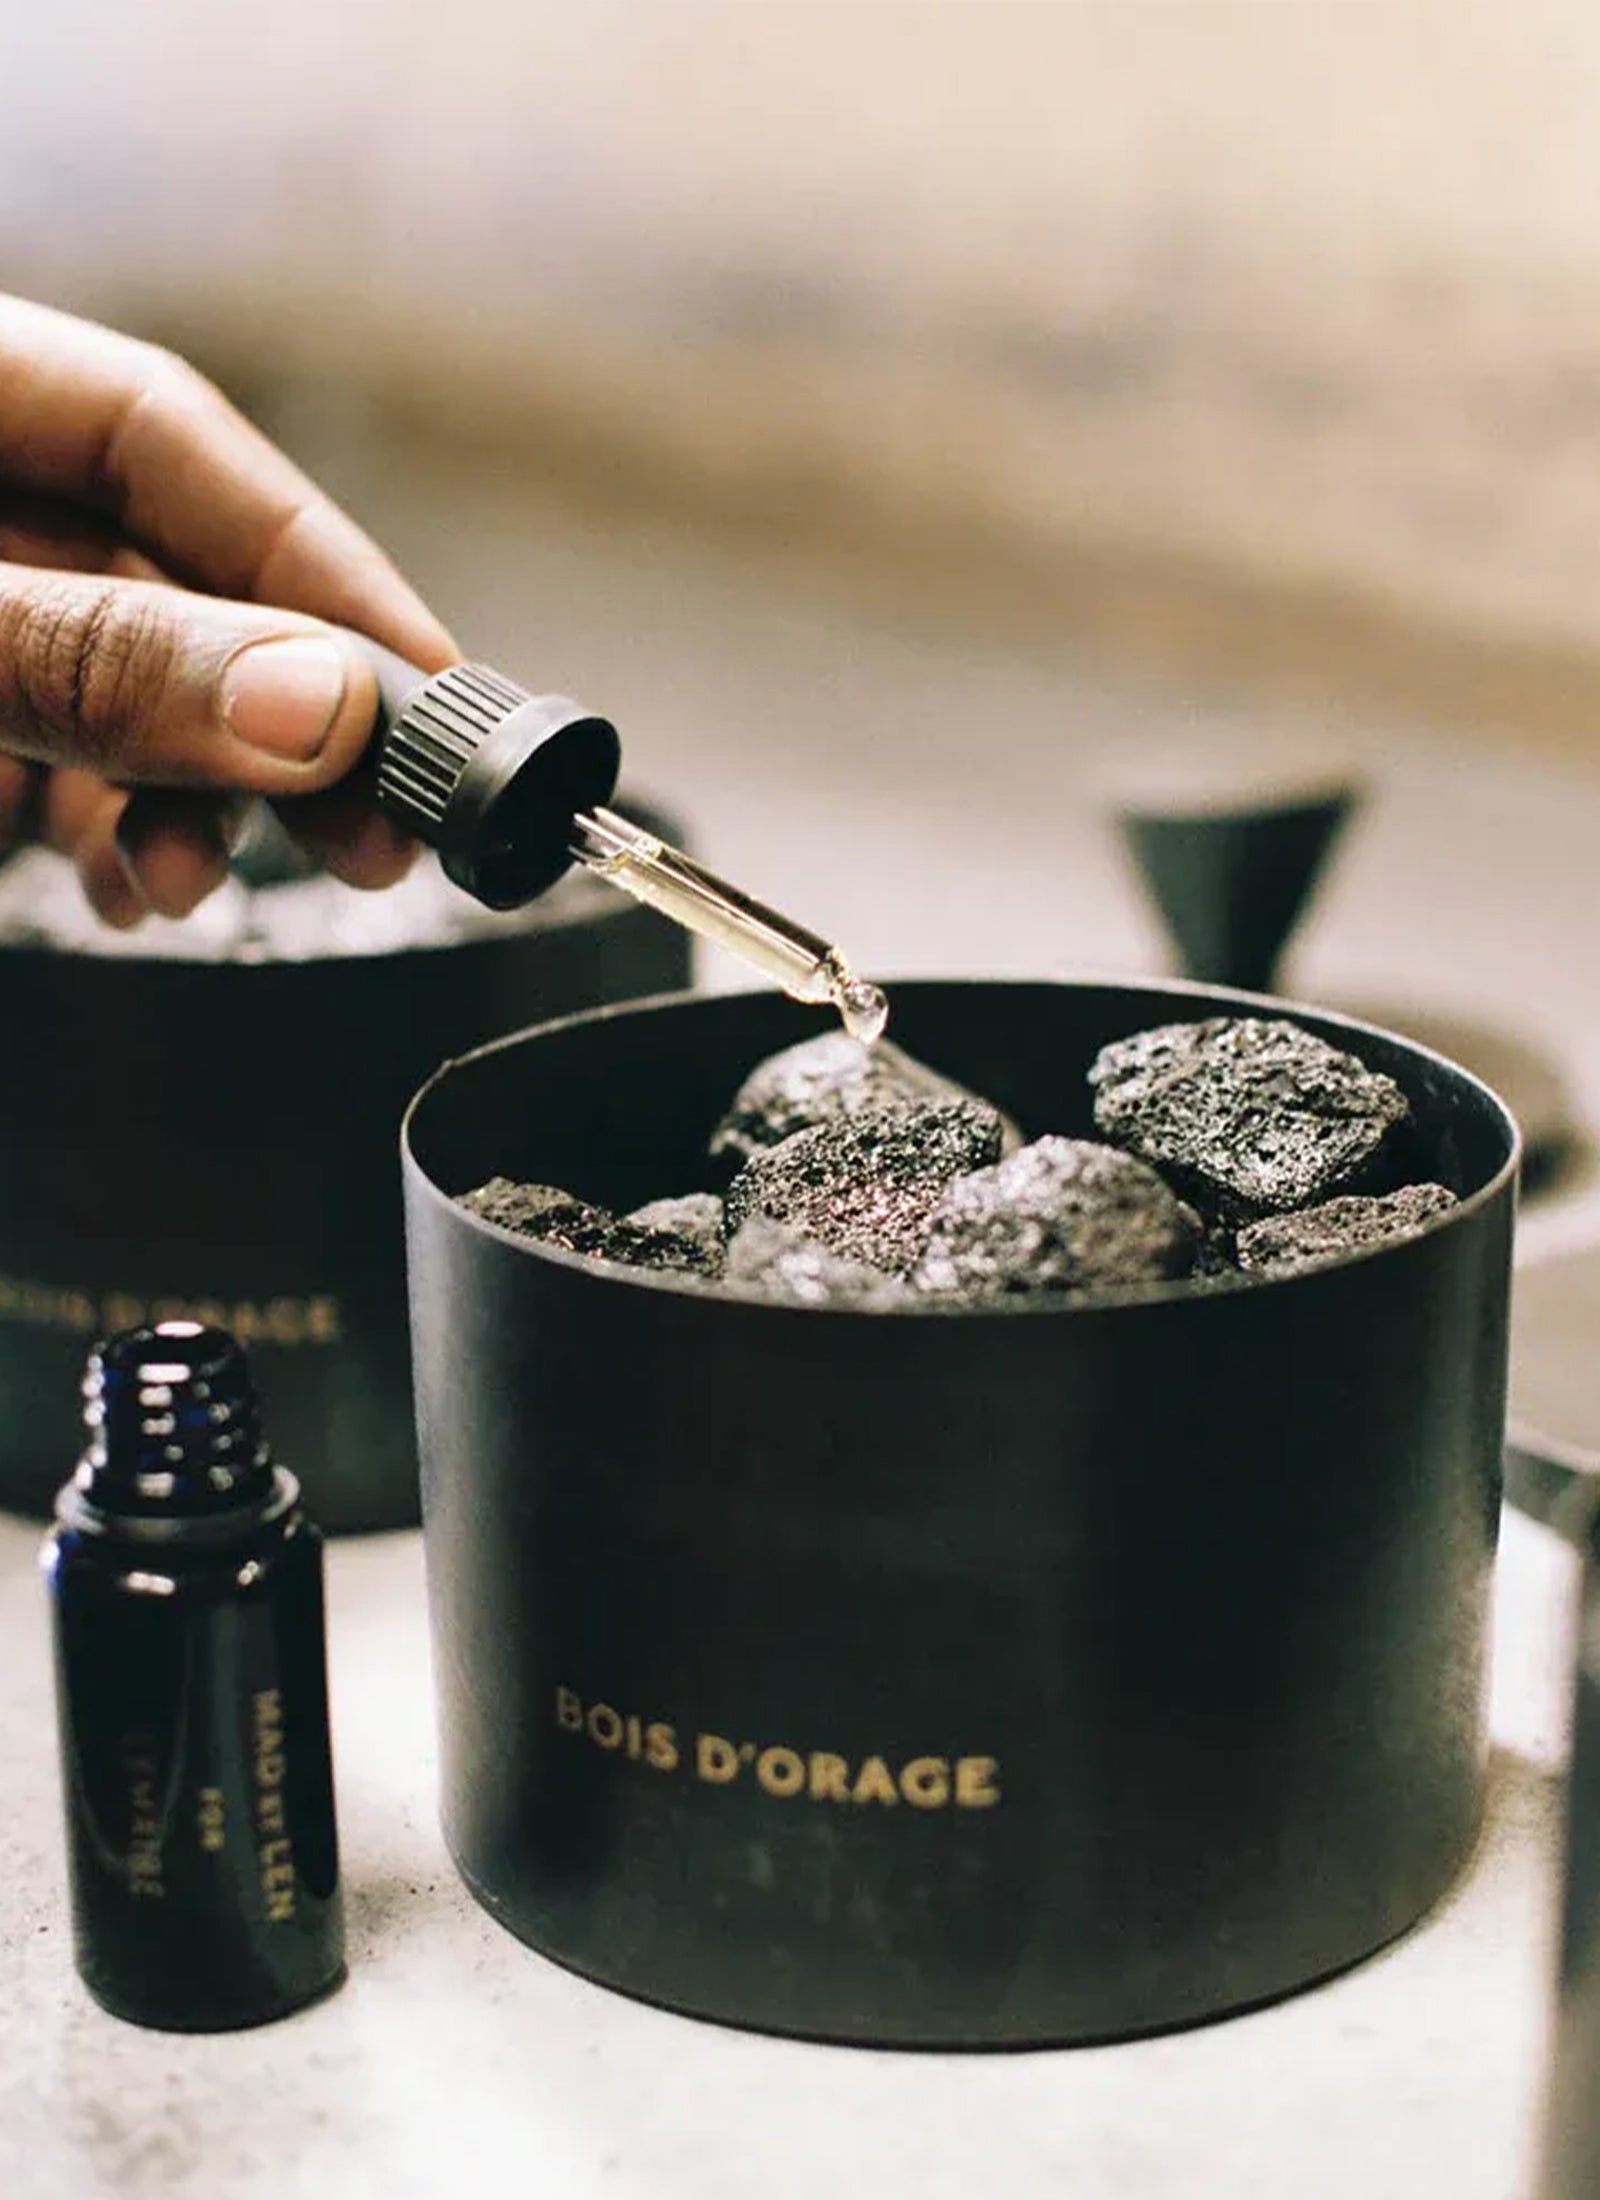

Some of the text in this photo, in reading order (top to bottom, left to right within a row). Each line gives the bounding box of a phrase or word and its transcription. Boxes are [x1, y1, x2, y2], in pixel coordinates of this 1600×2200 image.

[253, 1688, 286, 1787] MAD
[556, 1685, 1001, 1809] BOIS D'ORAGE
[259, 1838, 295, 1923] LEN
